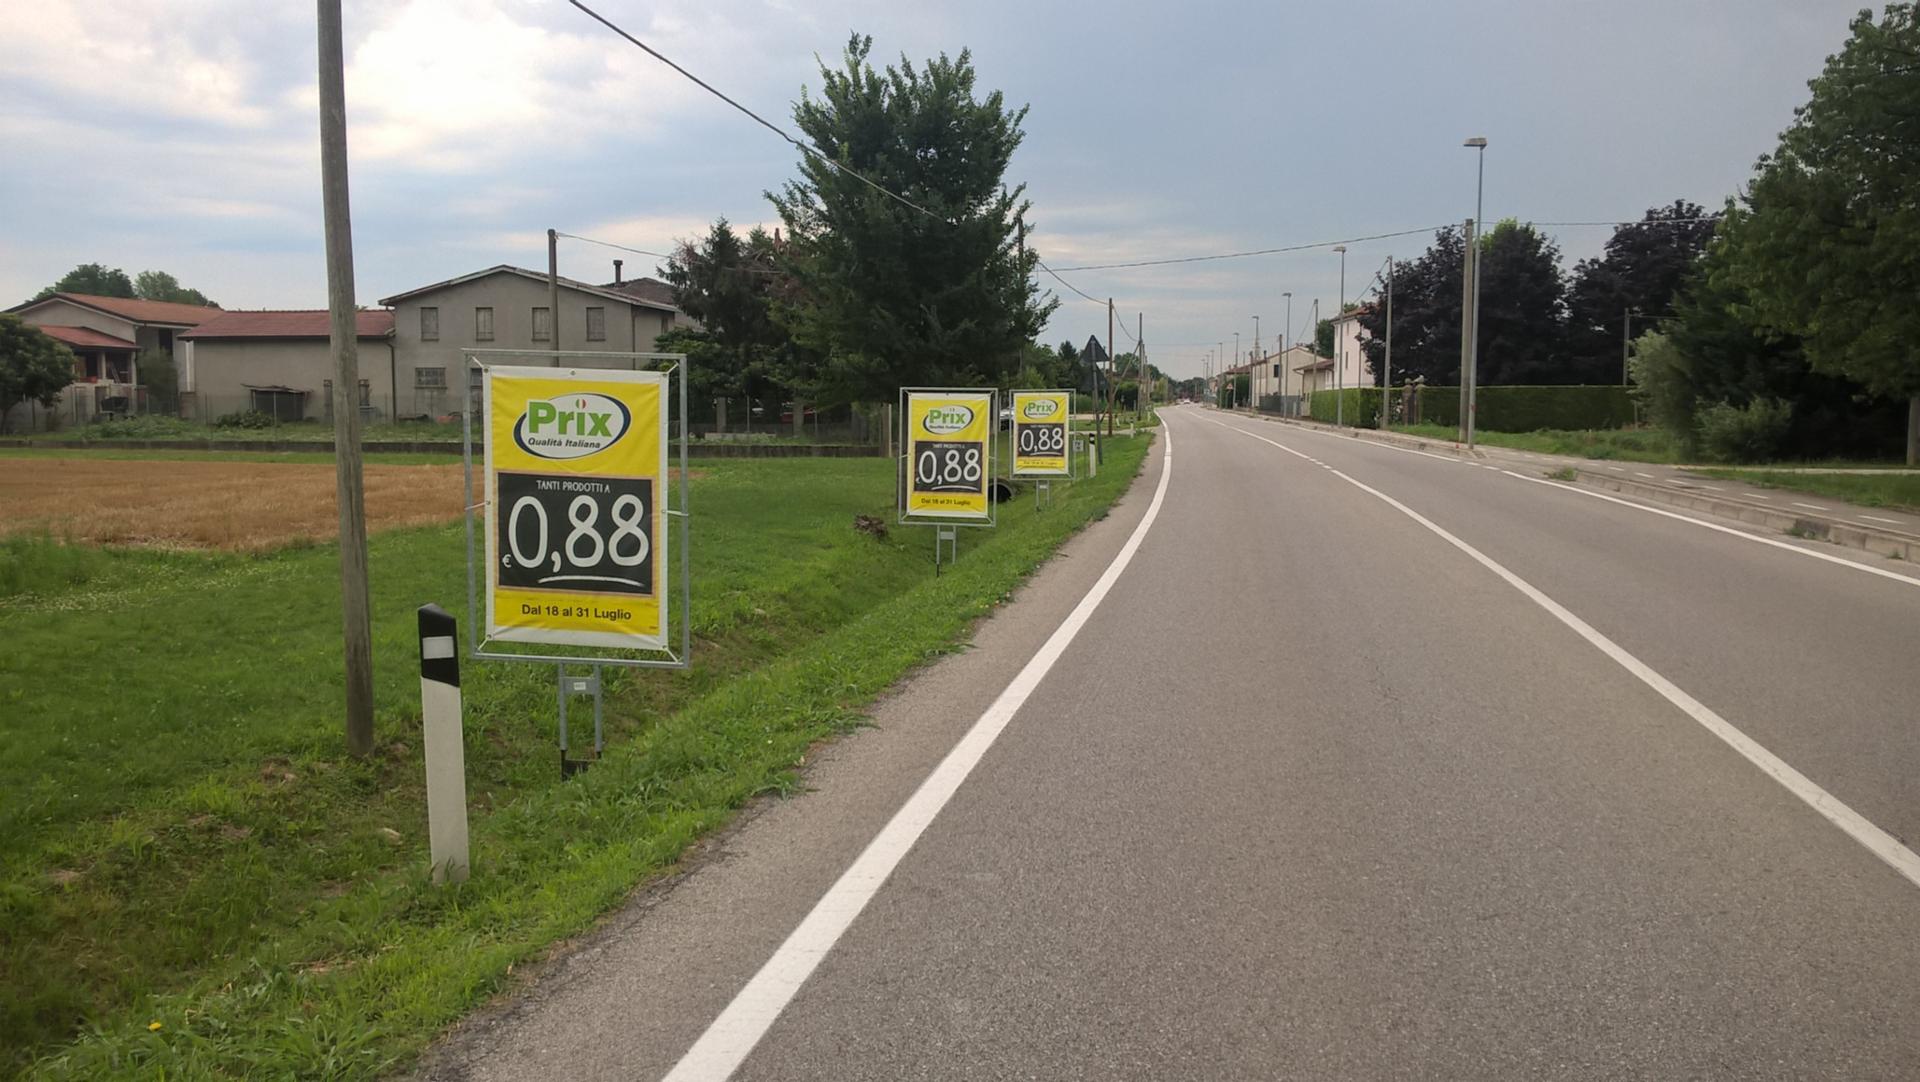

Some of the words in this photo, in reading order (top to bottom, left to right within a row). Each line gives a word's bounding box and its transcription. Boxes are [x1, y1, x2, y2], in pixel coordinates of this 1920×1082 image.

[1028, 401, 1052, 412] Prix
[528, 398, 613, 438] Prix
[929, 408, 966, 425] Prix
[528, 437, 563, 448] Qualità
[565, 439, 601, 449] Italiana
[536, 480, 560, 491] TANTI
[563, 481, 603, 493] PRODOTTI
[604, 485, 610, 493] A
[521, 604, 541, 615] Dal
[545, 606, 559, 616] 18
[562, 607, 572, 617] al
[576, 608, 590, 618] 31
[594, 608, 631, 621] Luglio
